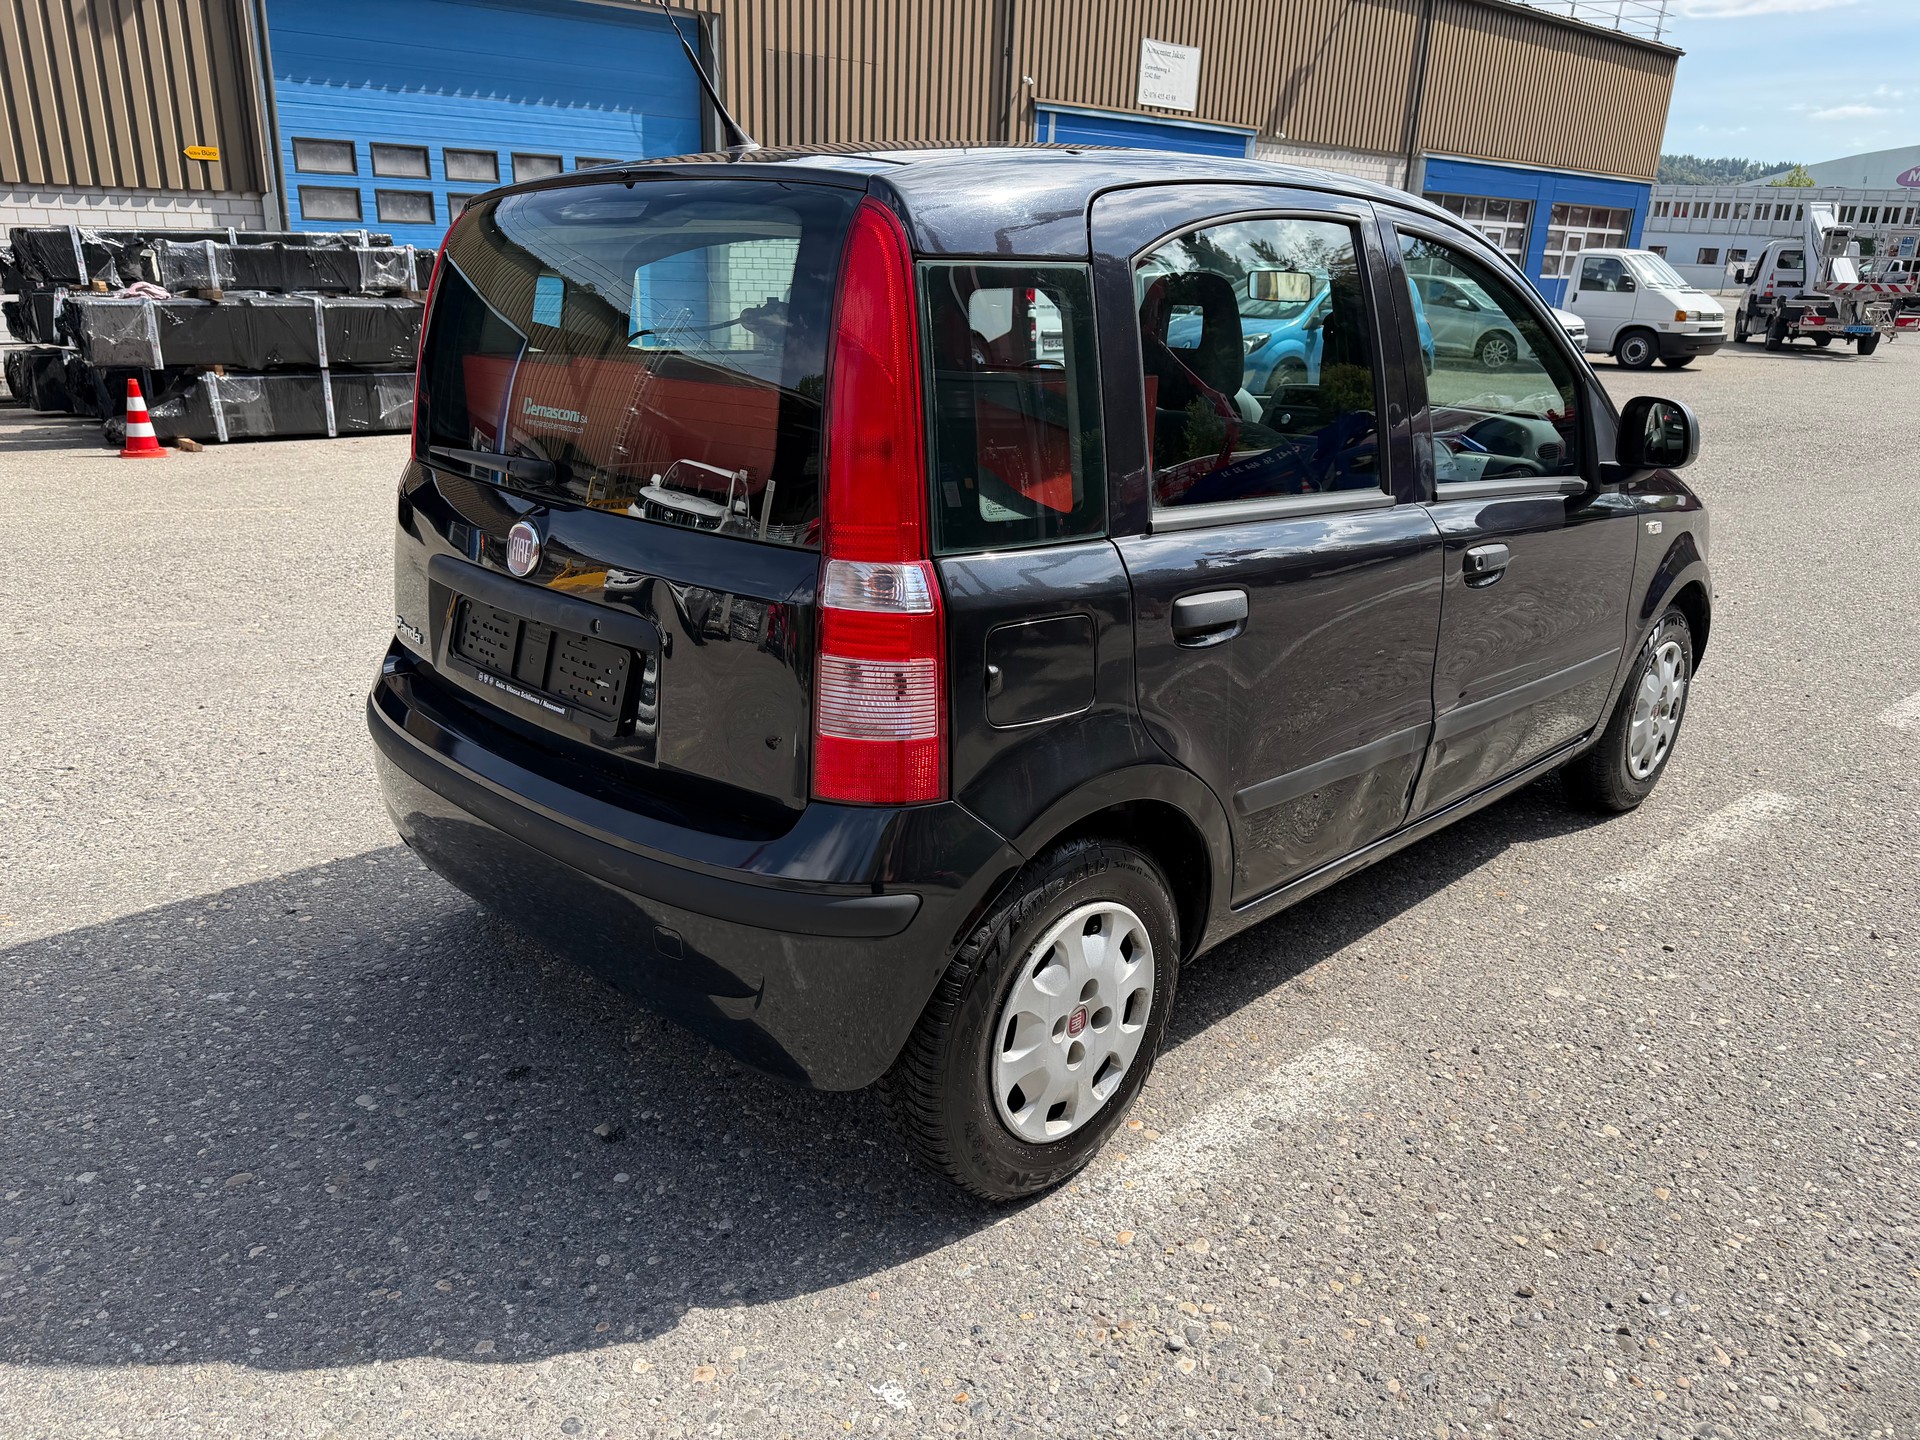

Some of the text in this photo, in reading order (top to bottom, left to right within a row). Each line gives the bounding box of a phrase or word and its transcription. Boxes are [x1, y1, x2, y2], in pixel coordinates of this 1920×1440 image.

[201, 149, 217, 157] Büro
[511, 536, 531, 564] FIAT
[1071, 1011, 1082, 1032] FIAT
